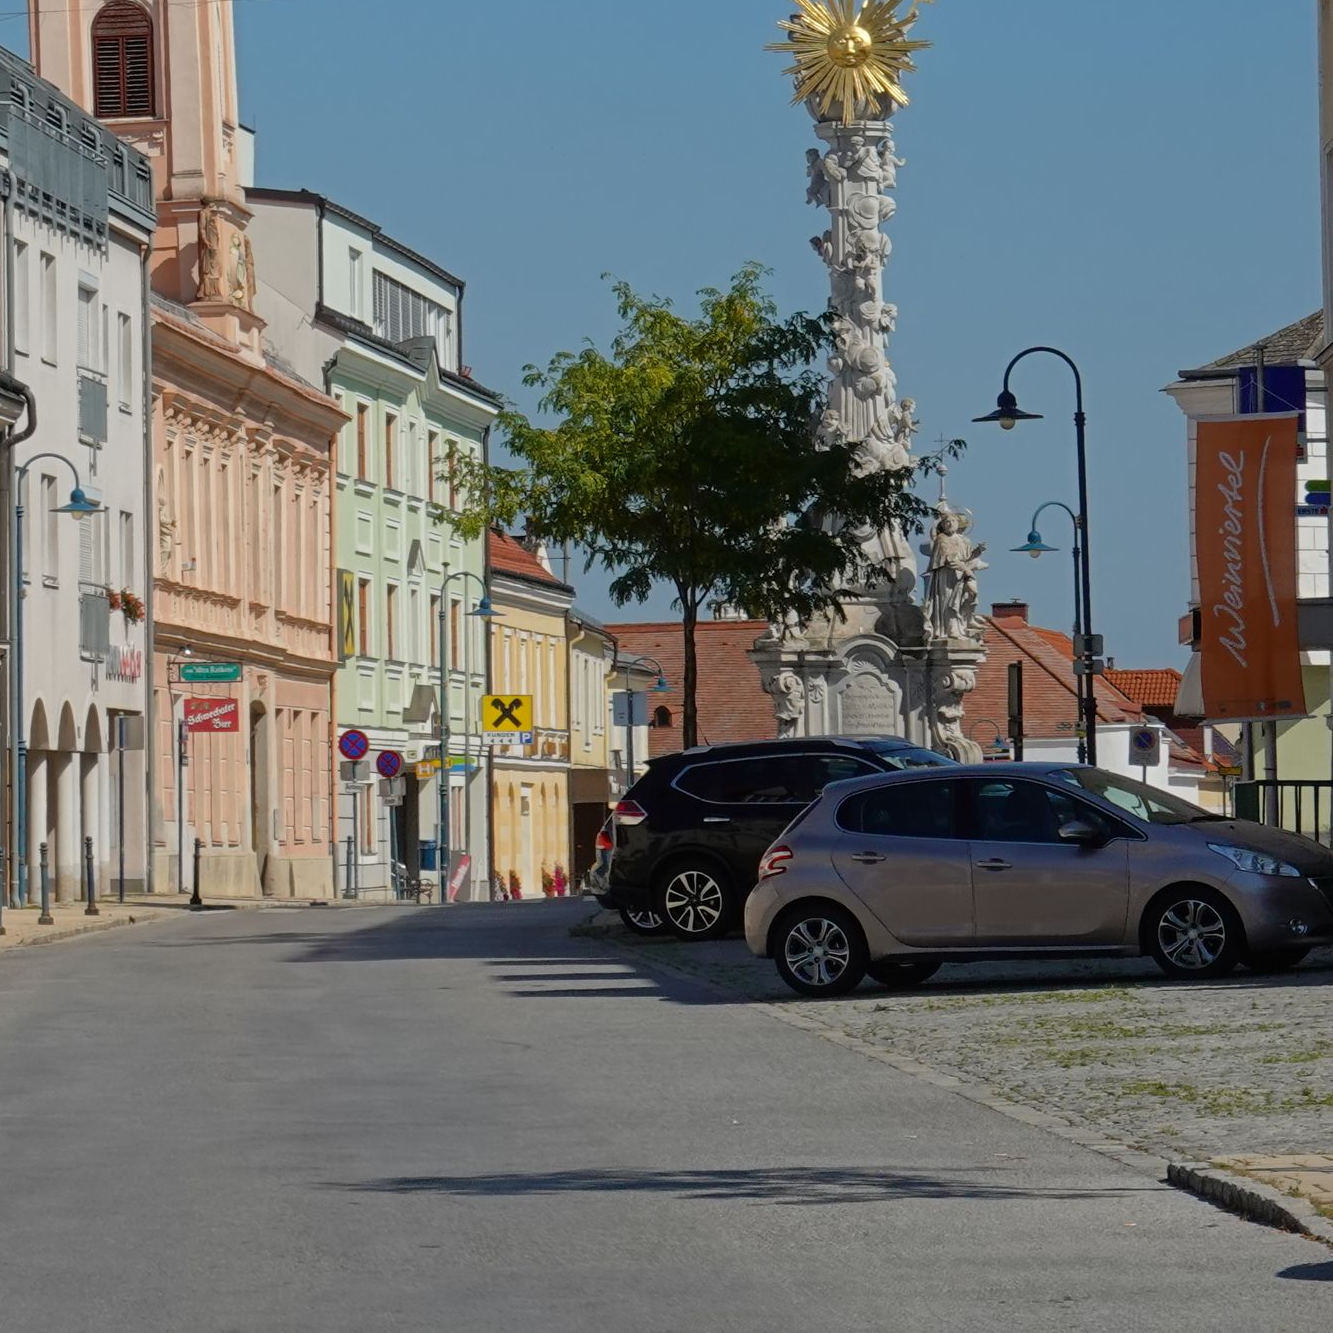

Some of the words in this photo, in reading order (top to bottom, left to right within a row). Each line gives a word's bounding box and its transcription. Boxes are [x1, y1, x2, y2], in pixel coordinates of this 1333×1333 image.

[1213, 449, 1248, 668] Weinviertel
[187, 703, 236, 725] Schwechater
[212, 717, 232, 729] Bier
[522, 732, 532, 744] P
